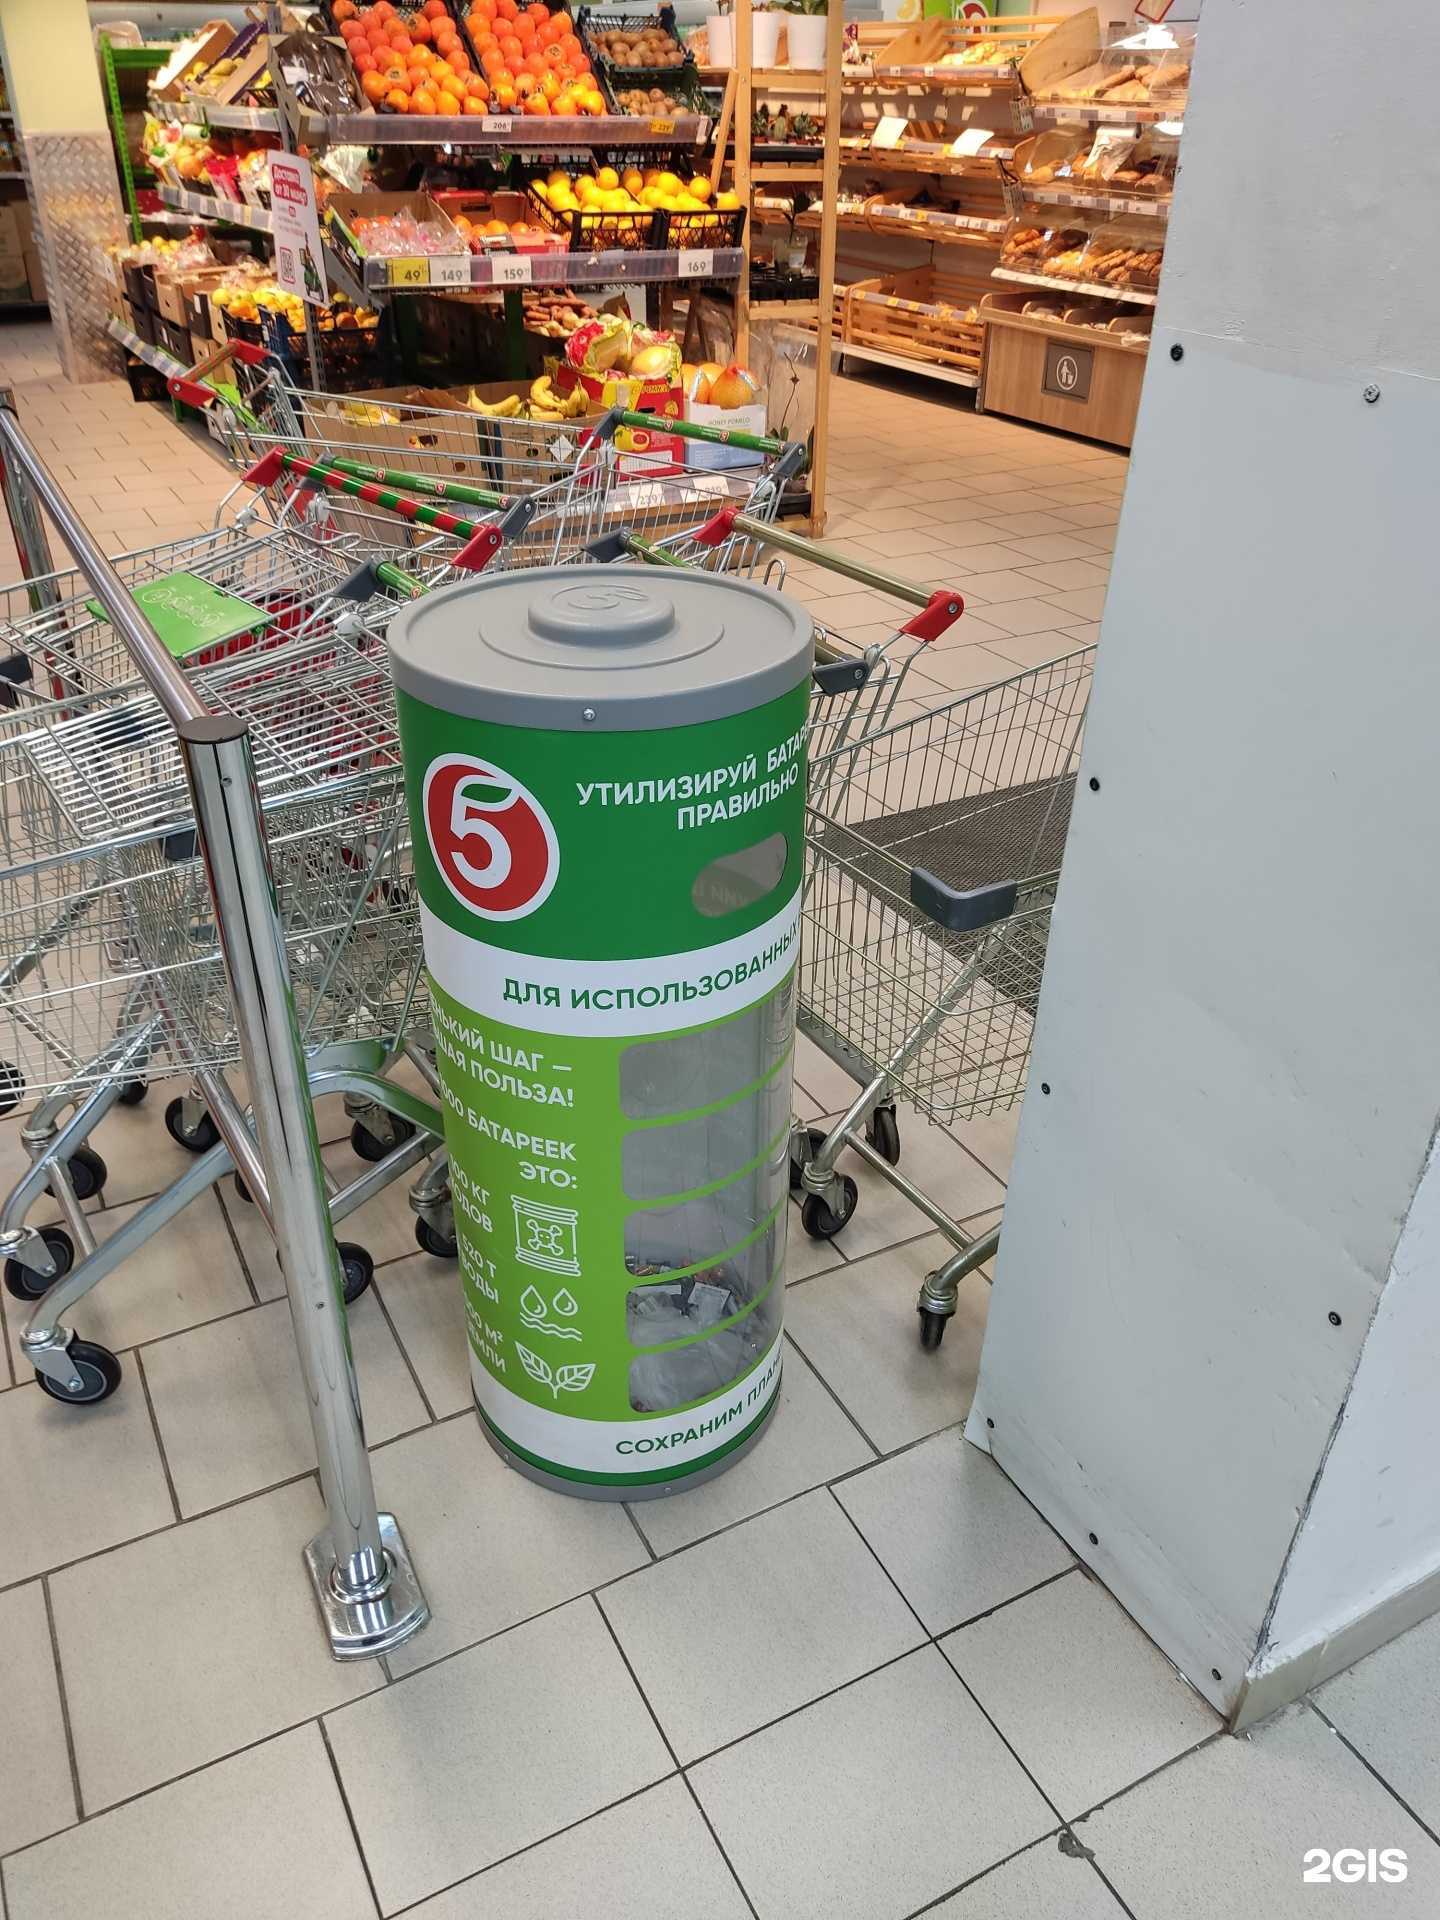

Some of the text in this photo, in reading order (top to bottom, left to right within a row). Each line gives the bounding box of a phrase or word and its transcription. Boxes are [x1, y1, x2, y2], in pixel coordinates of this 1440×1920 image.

[441, 269, 463, 281] 149
[504, 268, 524, 280] 159
[687, 261, 706, 273] 169
[576, 754, 756, 806] УТИЛИЗИРУЙ
[677, 763, 798, 830] ПРАВИЛЬНО
[451, 775, 518, 889] 5
[503, 916, 798, 1010] ДЛЯ ИСПОЛЬЗОВАННЫХ
[435, 1028, 574, 1107] ШАЯ ПОЛЬЗА!
[490, 1040, 544, 1072] ШАГ
[467, 1107, 577, 1161] БАТАРЕЕК
[471, 1180, 490, 1206] КГ
[518, 1161, 577, 1189] ЭТО:
[452, 1179, 493, 1233] ОДОВ
[486, 1258, 497, 1279] Т
[616, 1347, 781, 1455] СОХРАНИМ ПЛАН
